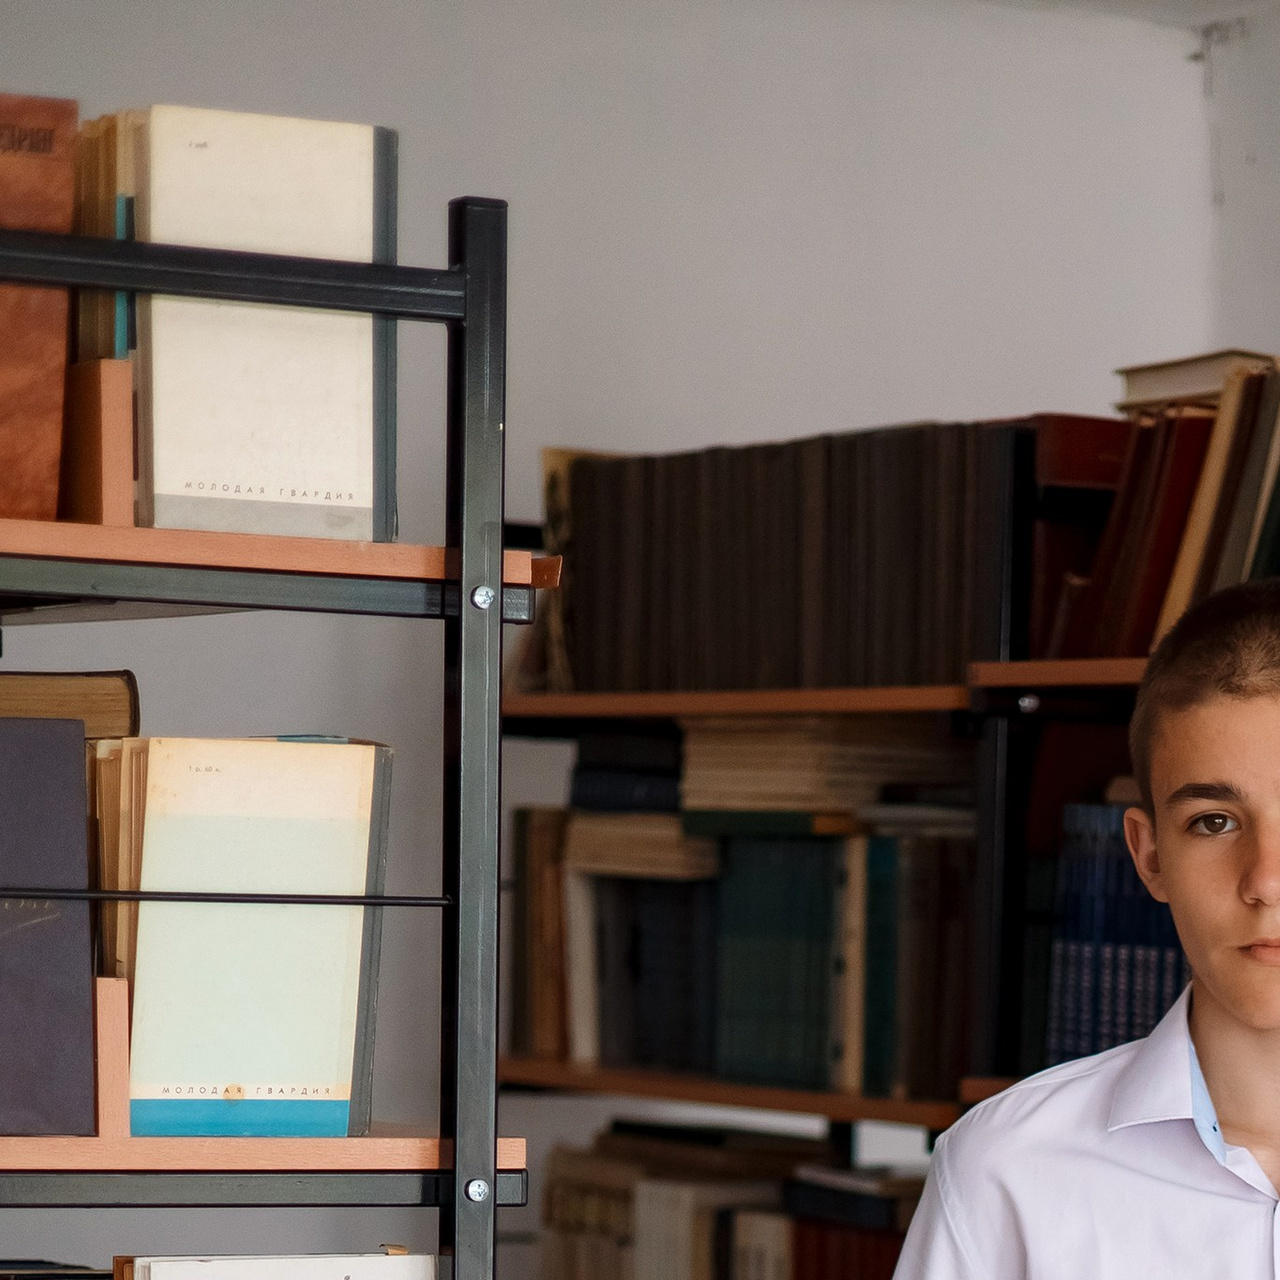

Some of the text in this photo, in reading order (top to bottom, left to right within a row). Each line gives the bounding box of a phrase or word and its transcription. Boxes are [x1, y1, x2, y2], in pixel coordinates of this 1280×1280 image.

[185, 482, 353, 500] МОЛОДАЯ ГВАРДИЯ
[162, 1086, 330, 1095] МОЛОДАЯ ГВАРДИЯ
